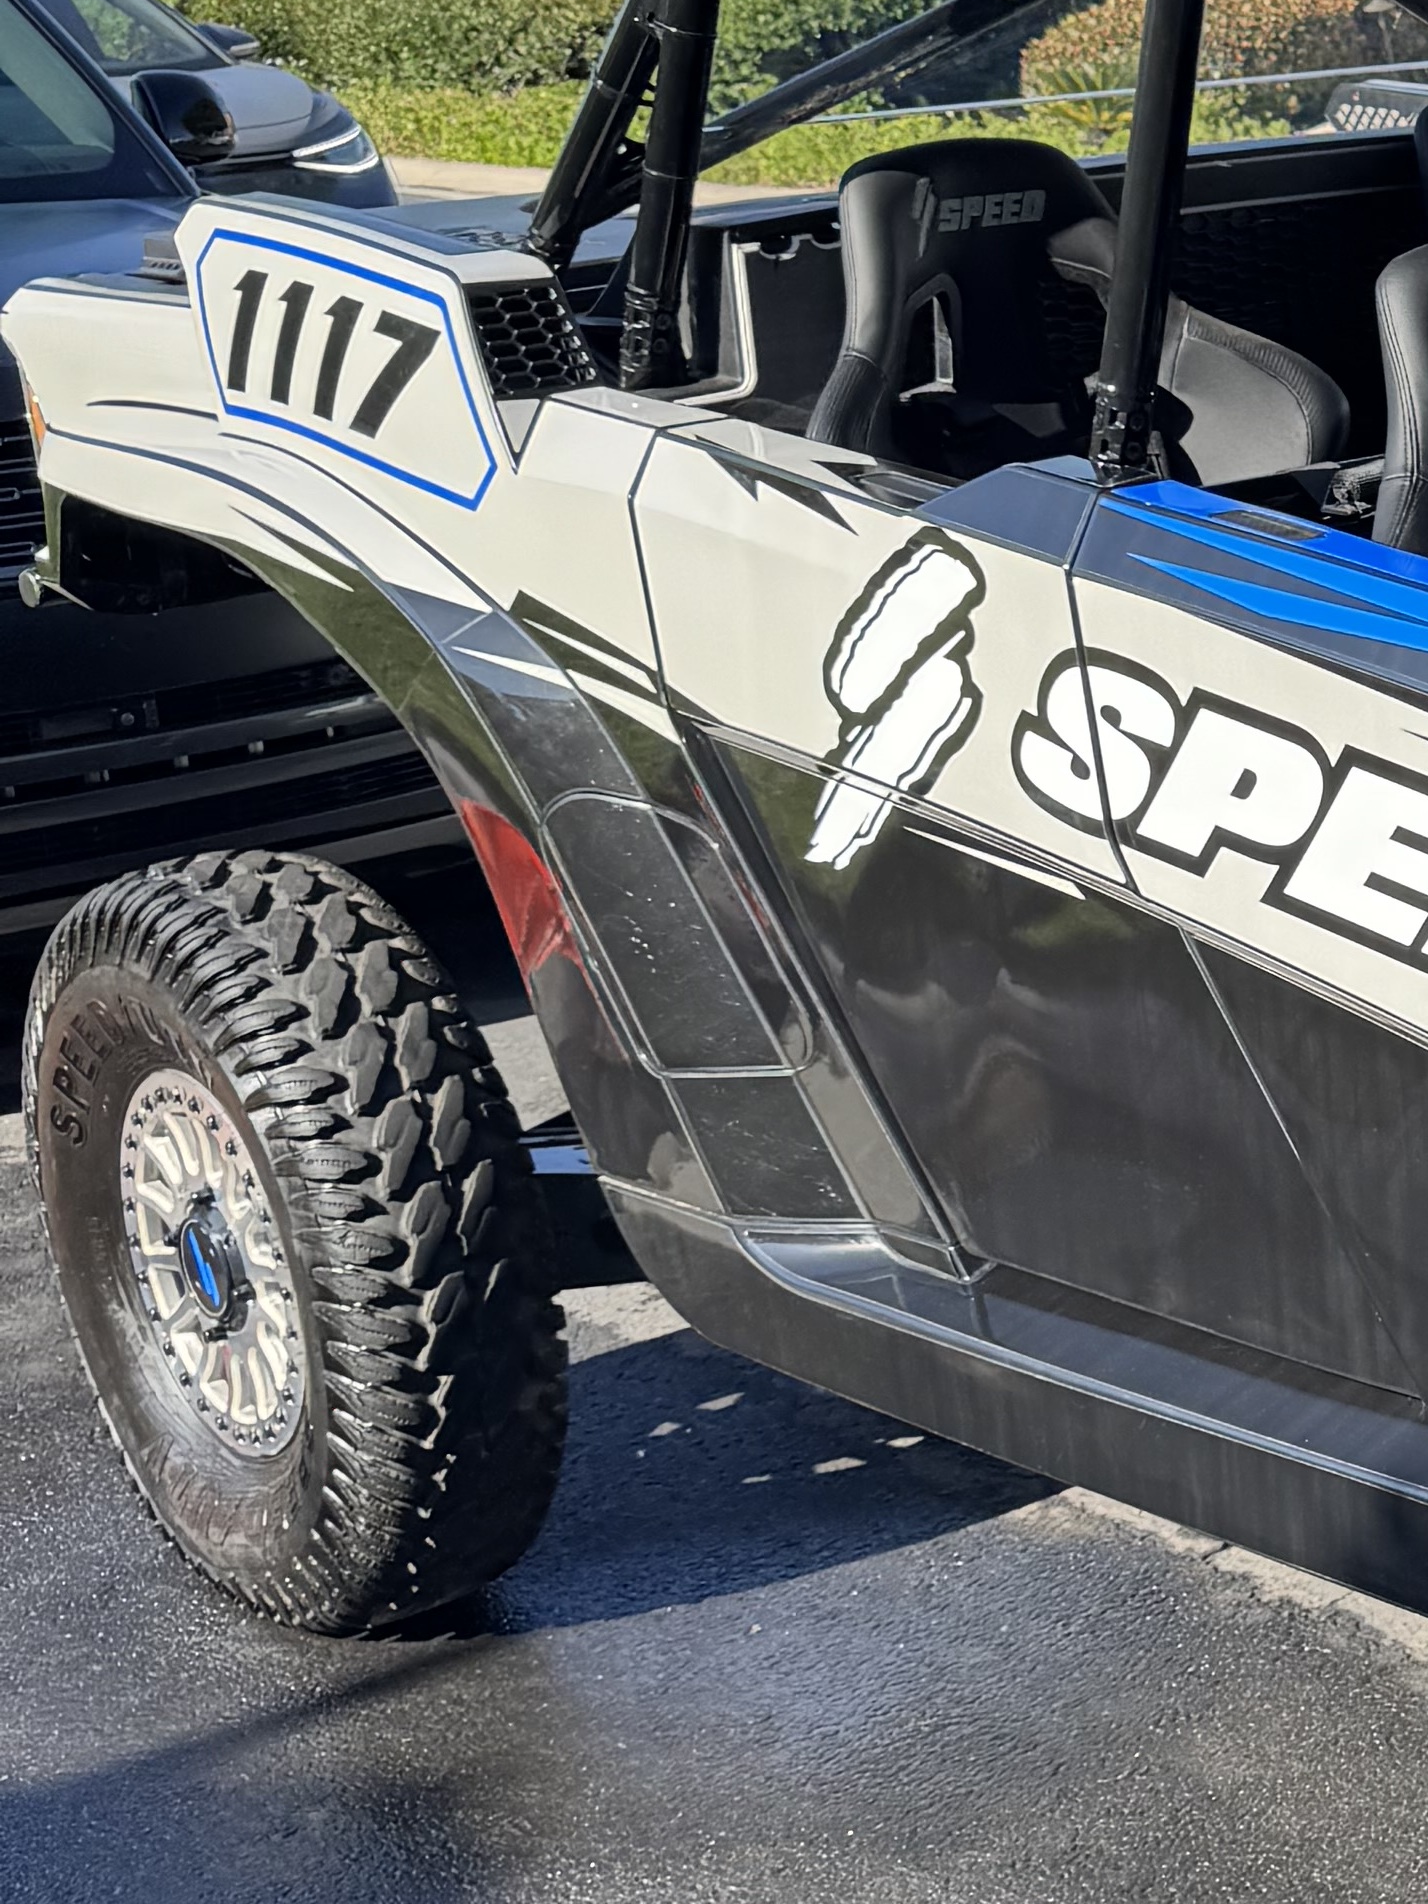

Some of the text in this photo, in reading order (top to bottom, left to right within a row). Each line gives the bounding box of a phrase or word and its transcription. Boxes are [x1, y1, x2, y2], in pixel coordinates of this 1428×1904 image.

[938, 189, 1046, 233] SPEED
[227, 269, 442, 440] 1117
[51, 998, 125, 1148] SPEED
